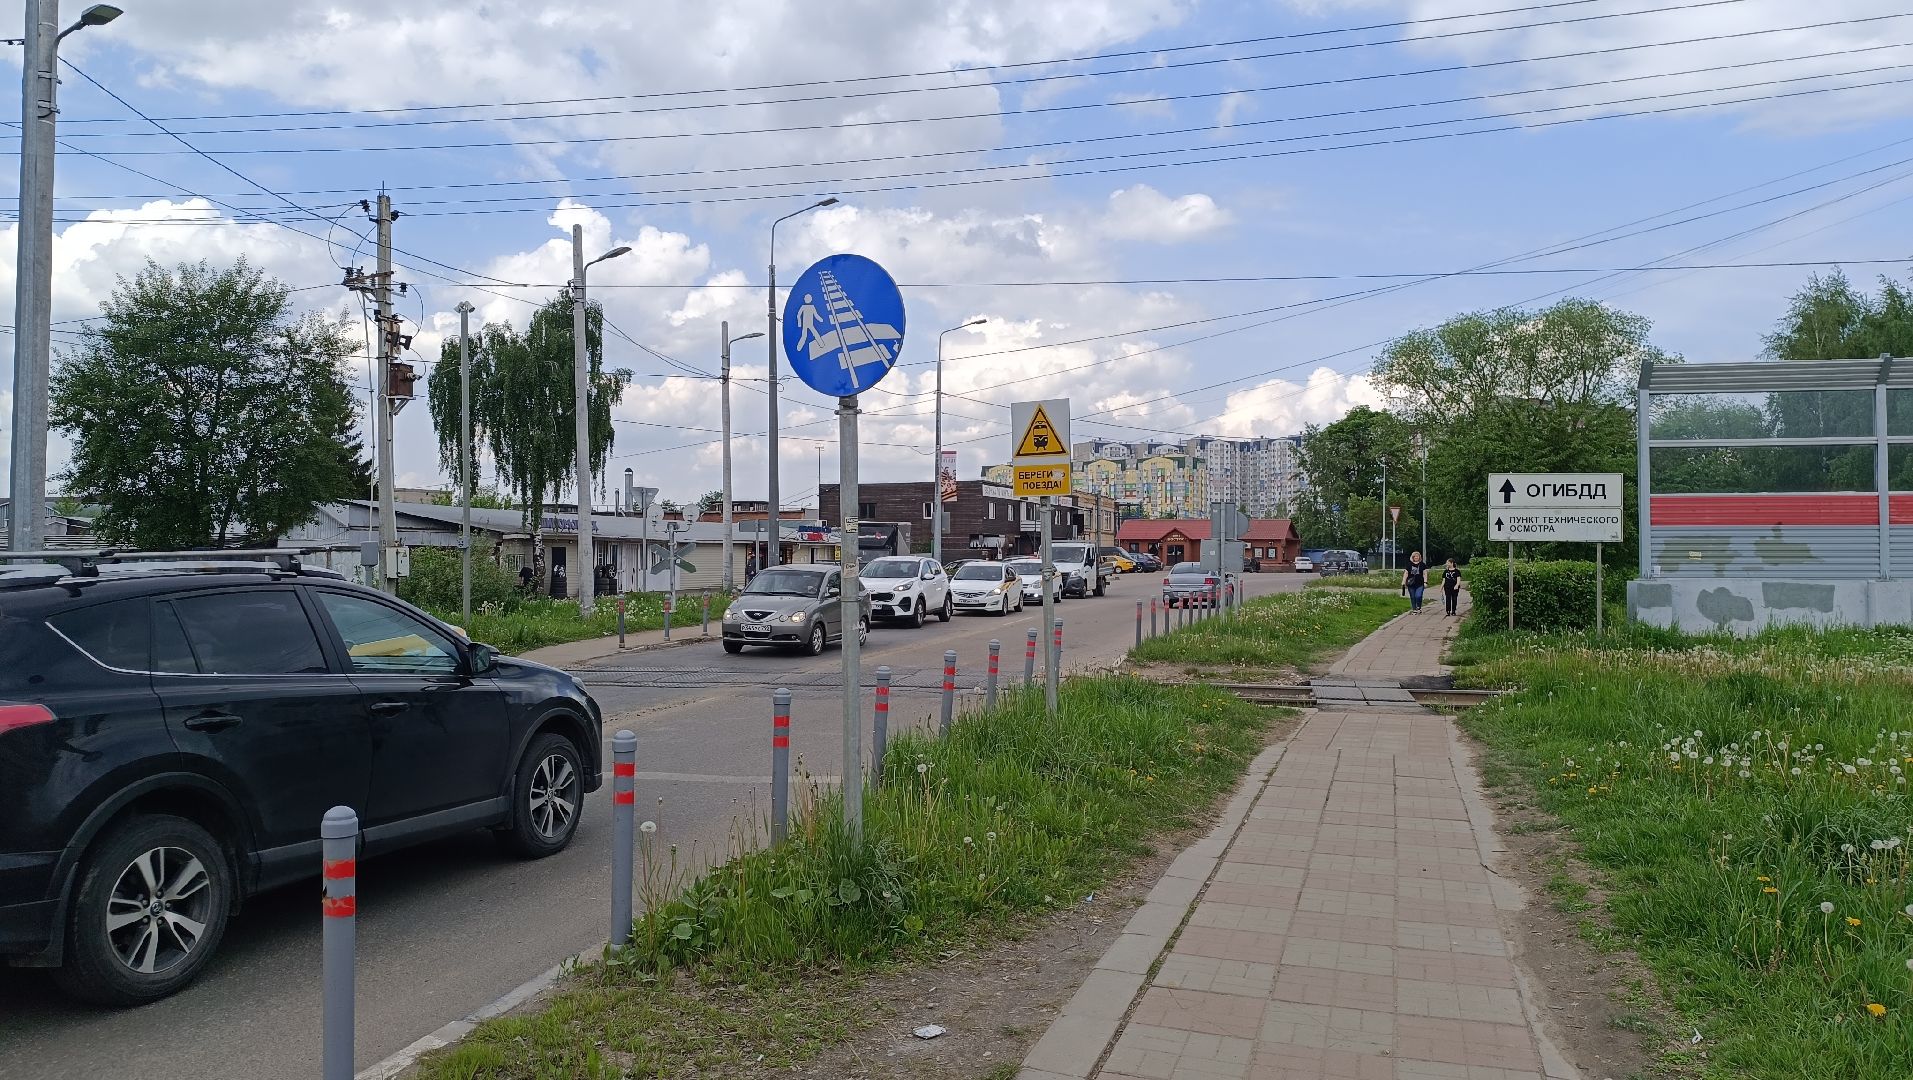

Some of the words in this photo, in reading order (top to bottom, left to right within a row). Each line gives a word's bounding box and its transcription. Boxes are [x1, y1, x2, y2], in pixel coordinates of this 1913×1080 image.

[1018, 470, 1066, 480] БЕРЕГИ
[1022, 481, 1062, 490] ПОЕЗДА!
[1526, 483, 1607, 500] ОГИБДД
[1509, 516, 1539, 524] ПУНКТ
[1542, 516, 1619, 524] ТЕХНИЧЕСКОГО
[1509, 525, 1556, 533] ОСМОТРА
